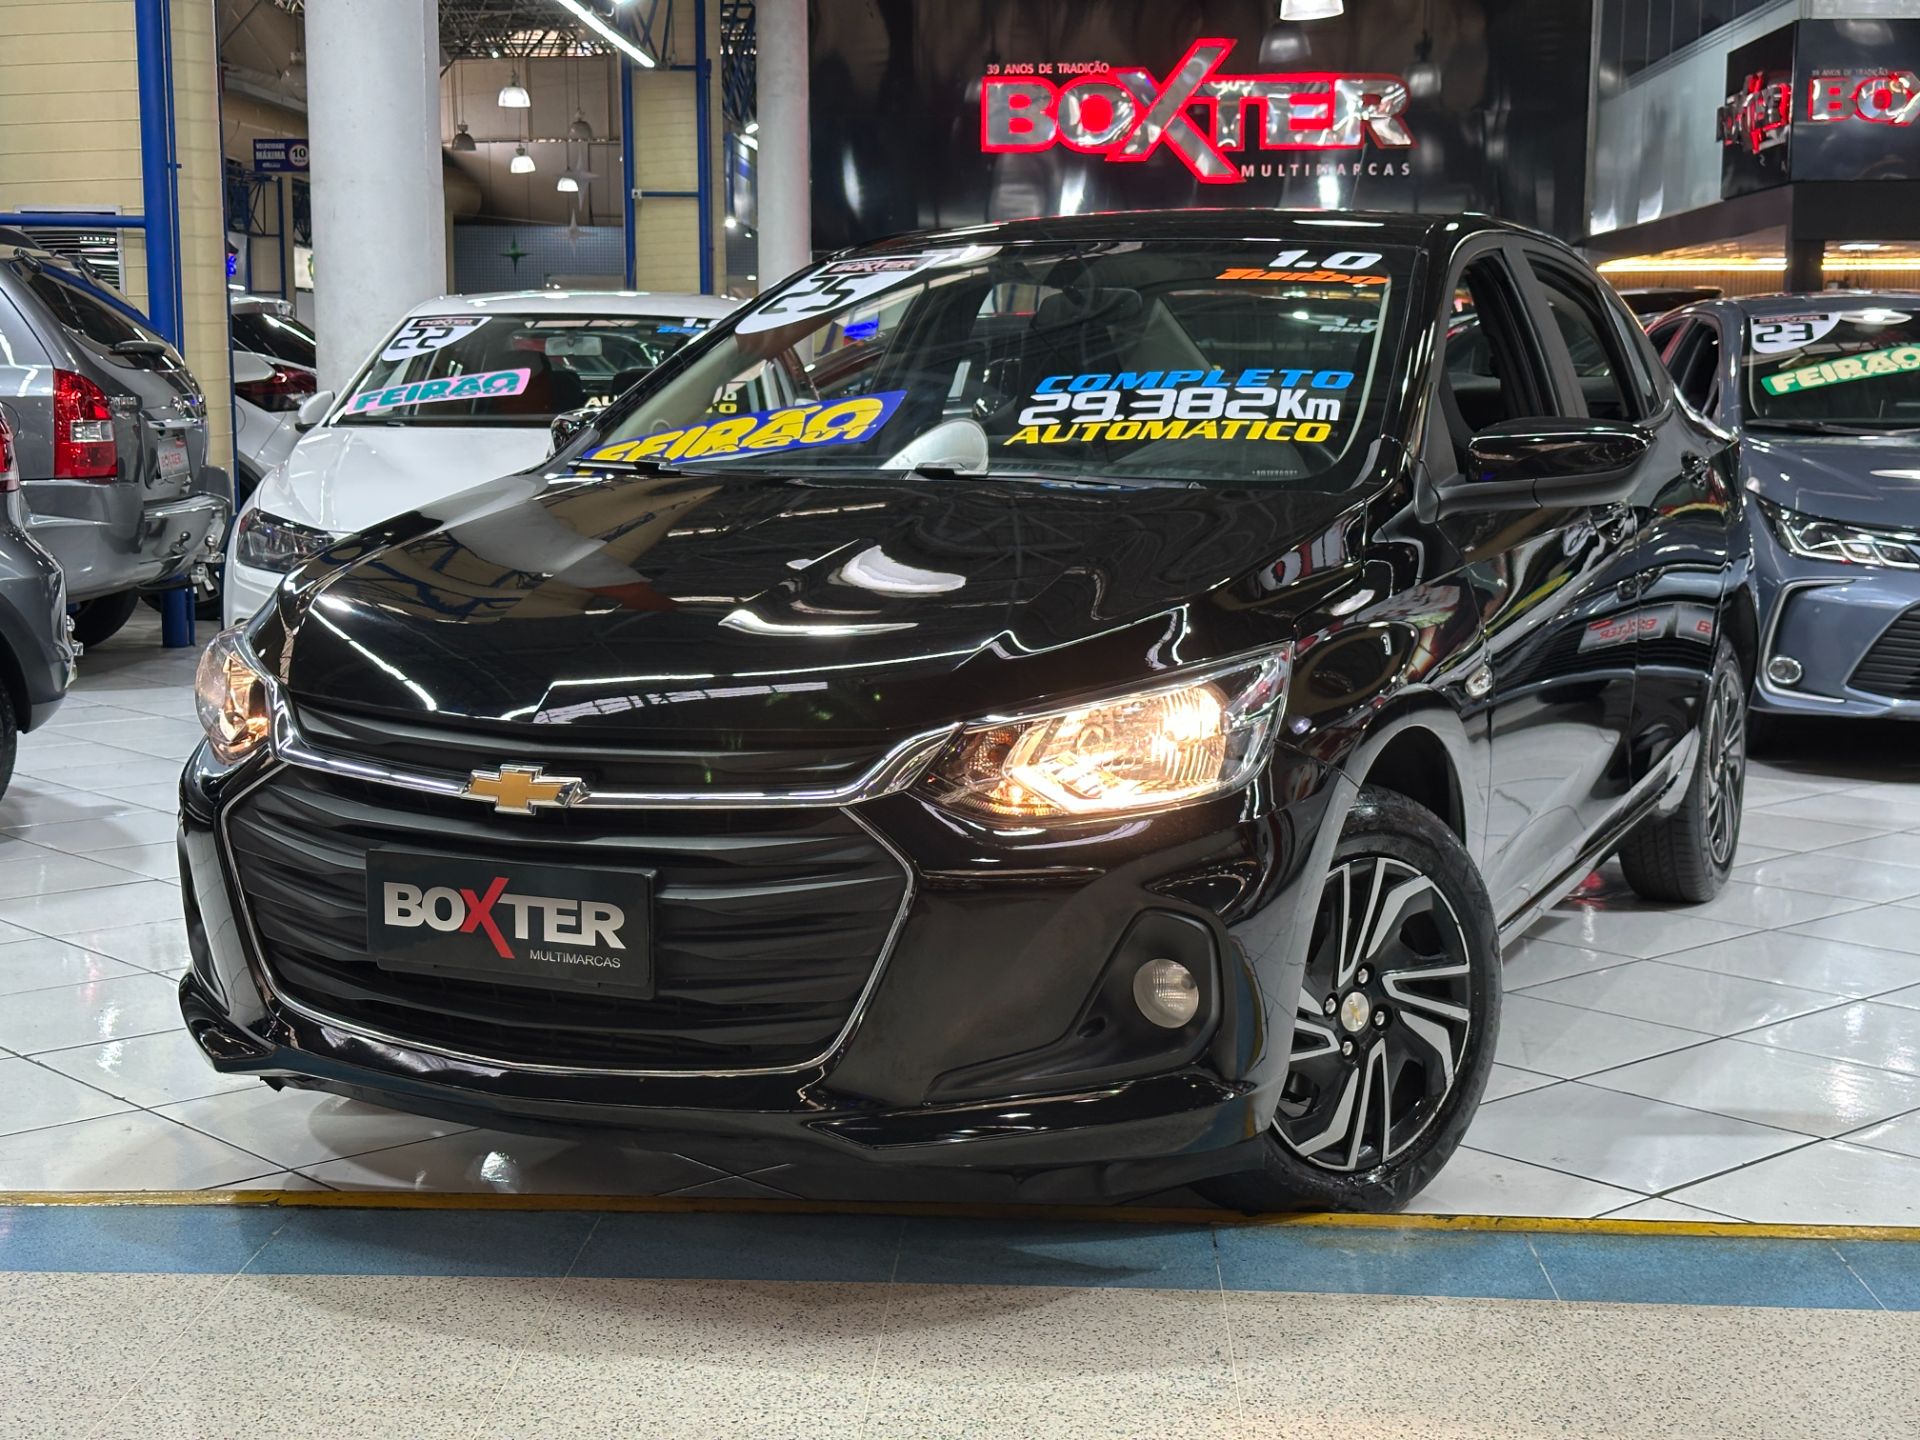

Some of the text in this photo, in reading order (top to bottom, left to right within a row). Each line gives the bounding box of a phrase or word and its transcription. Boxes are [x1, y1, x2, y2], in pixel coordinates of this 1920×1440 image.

[987, 60, 1110, 76] 39 ANOS DE TRADIÇÃO
[980, 37, 1417, 184] BOXTER
[292, 147, 306, 158] 10
[1241, 162, 1411, 178] MULTIMARCAS
[1267, 248, 1383, 271] 1.0
[1215, 268, 1391, 286] Turbo
[757, 273, 878, 315] 25
[389, 326, 454, 350] 22
[1755, 322, 1814, 344] 23
[1034, 368, 1355, 394] COMPLETO
[1770, 346, 1920, 393] FEIRÃO
[353, 371, 520, 411] FEIRÃO
[1017, 386, 1341, 426] 29.382Km
[383, 876, 627, 960] BOXTER
[529, 949, 621, 968] MULTIMARCAS
